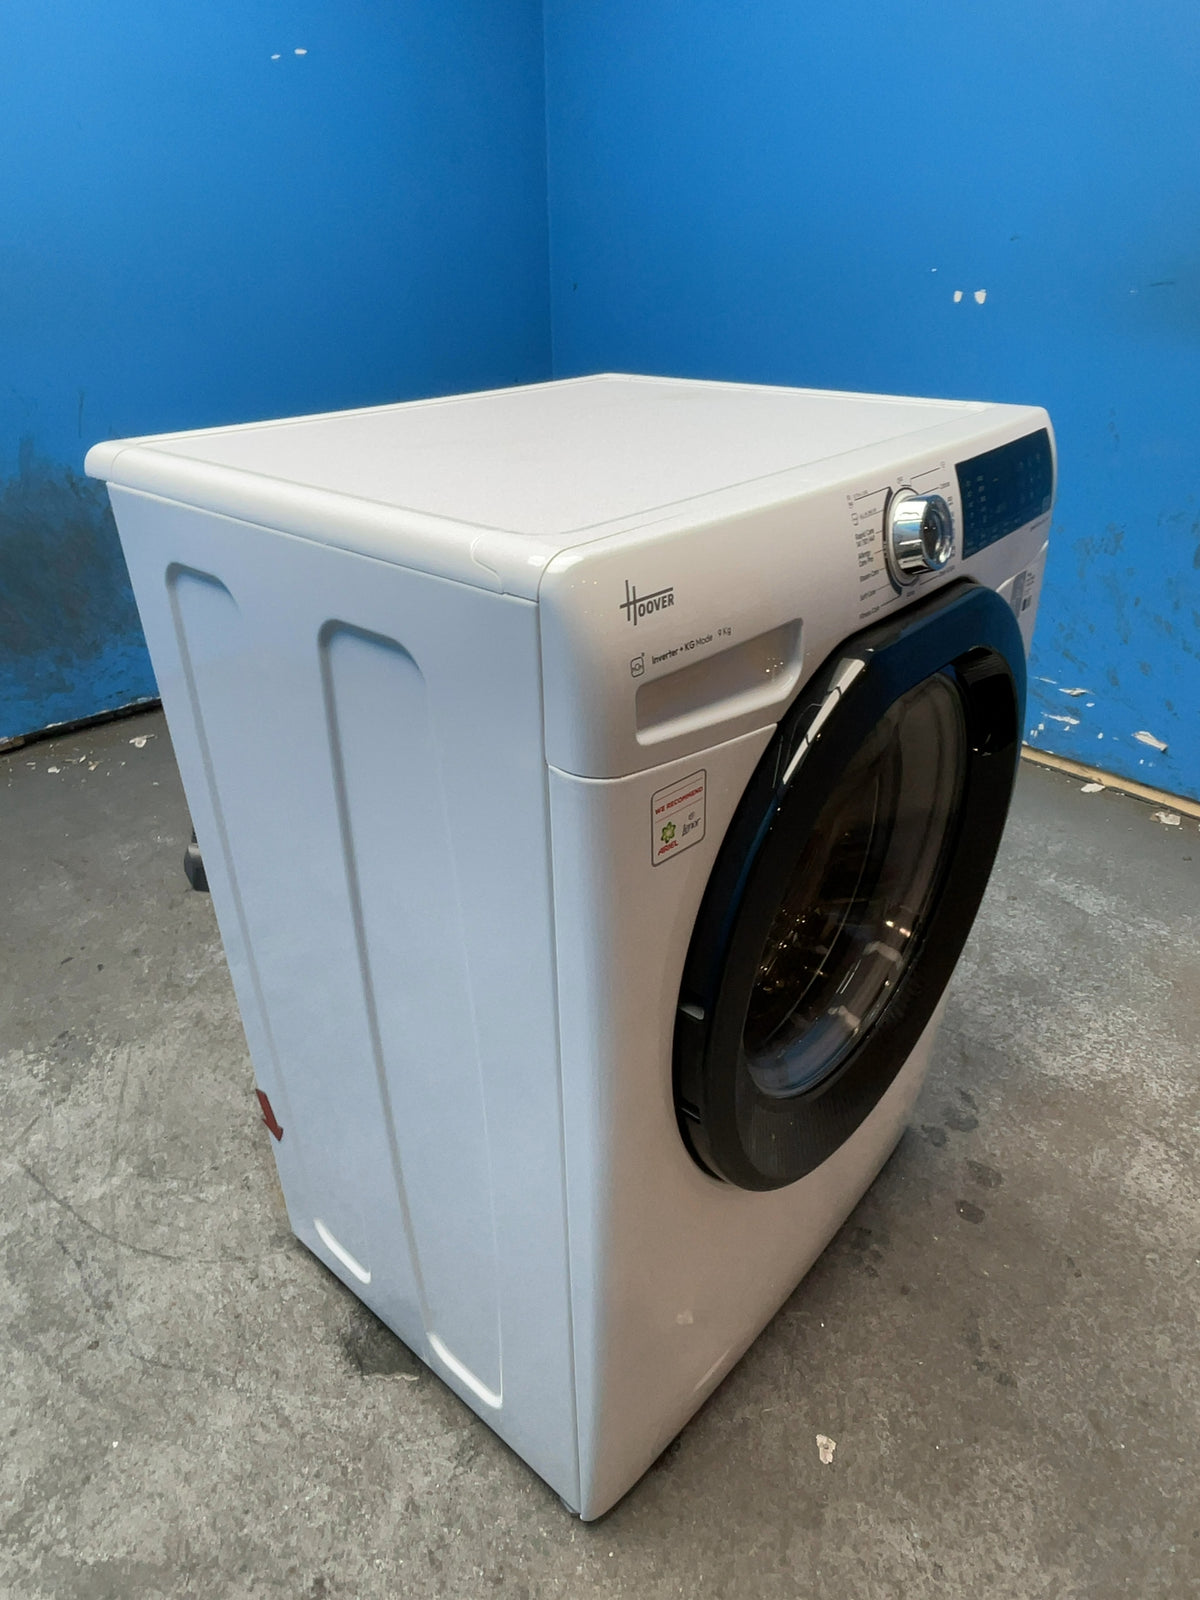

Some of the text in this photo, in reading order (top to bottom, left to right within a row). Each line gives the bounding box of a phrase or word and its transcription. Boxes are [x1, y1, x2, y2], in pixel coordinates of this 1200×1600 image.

[620, 580, 674, 626] HOOVER
[652, 648, 679, 664] Inverter
[684, 640, 695, 651] KG
[696, 634, 713, 645] Mode
[655, 786, 703, 815] WE RECOMMEND
